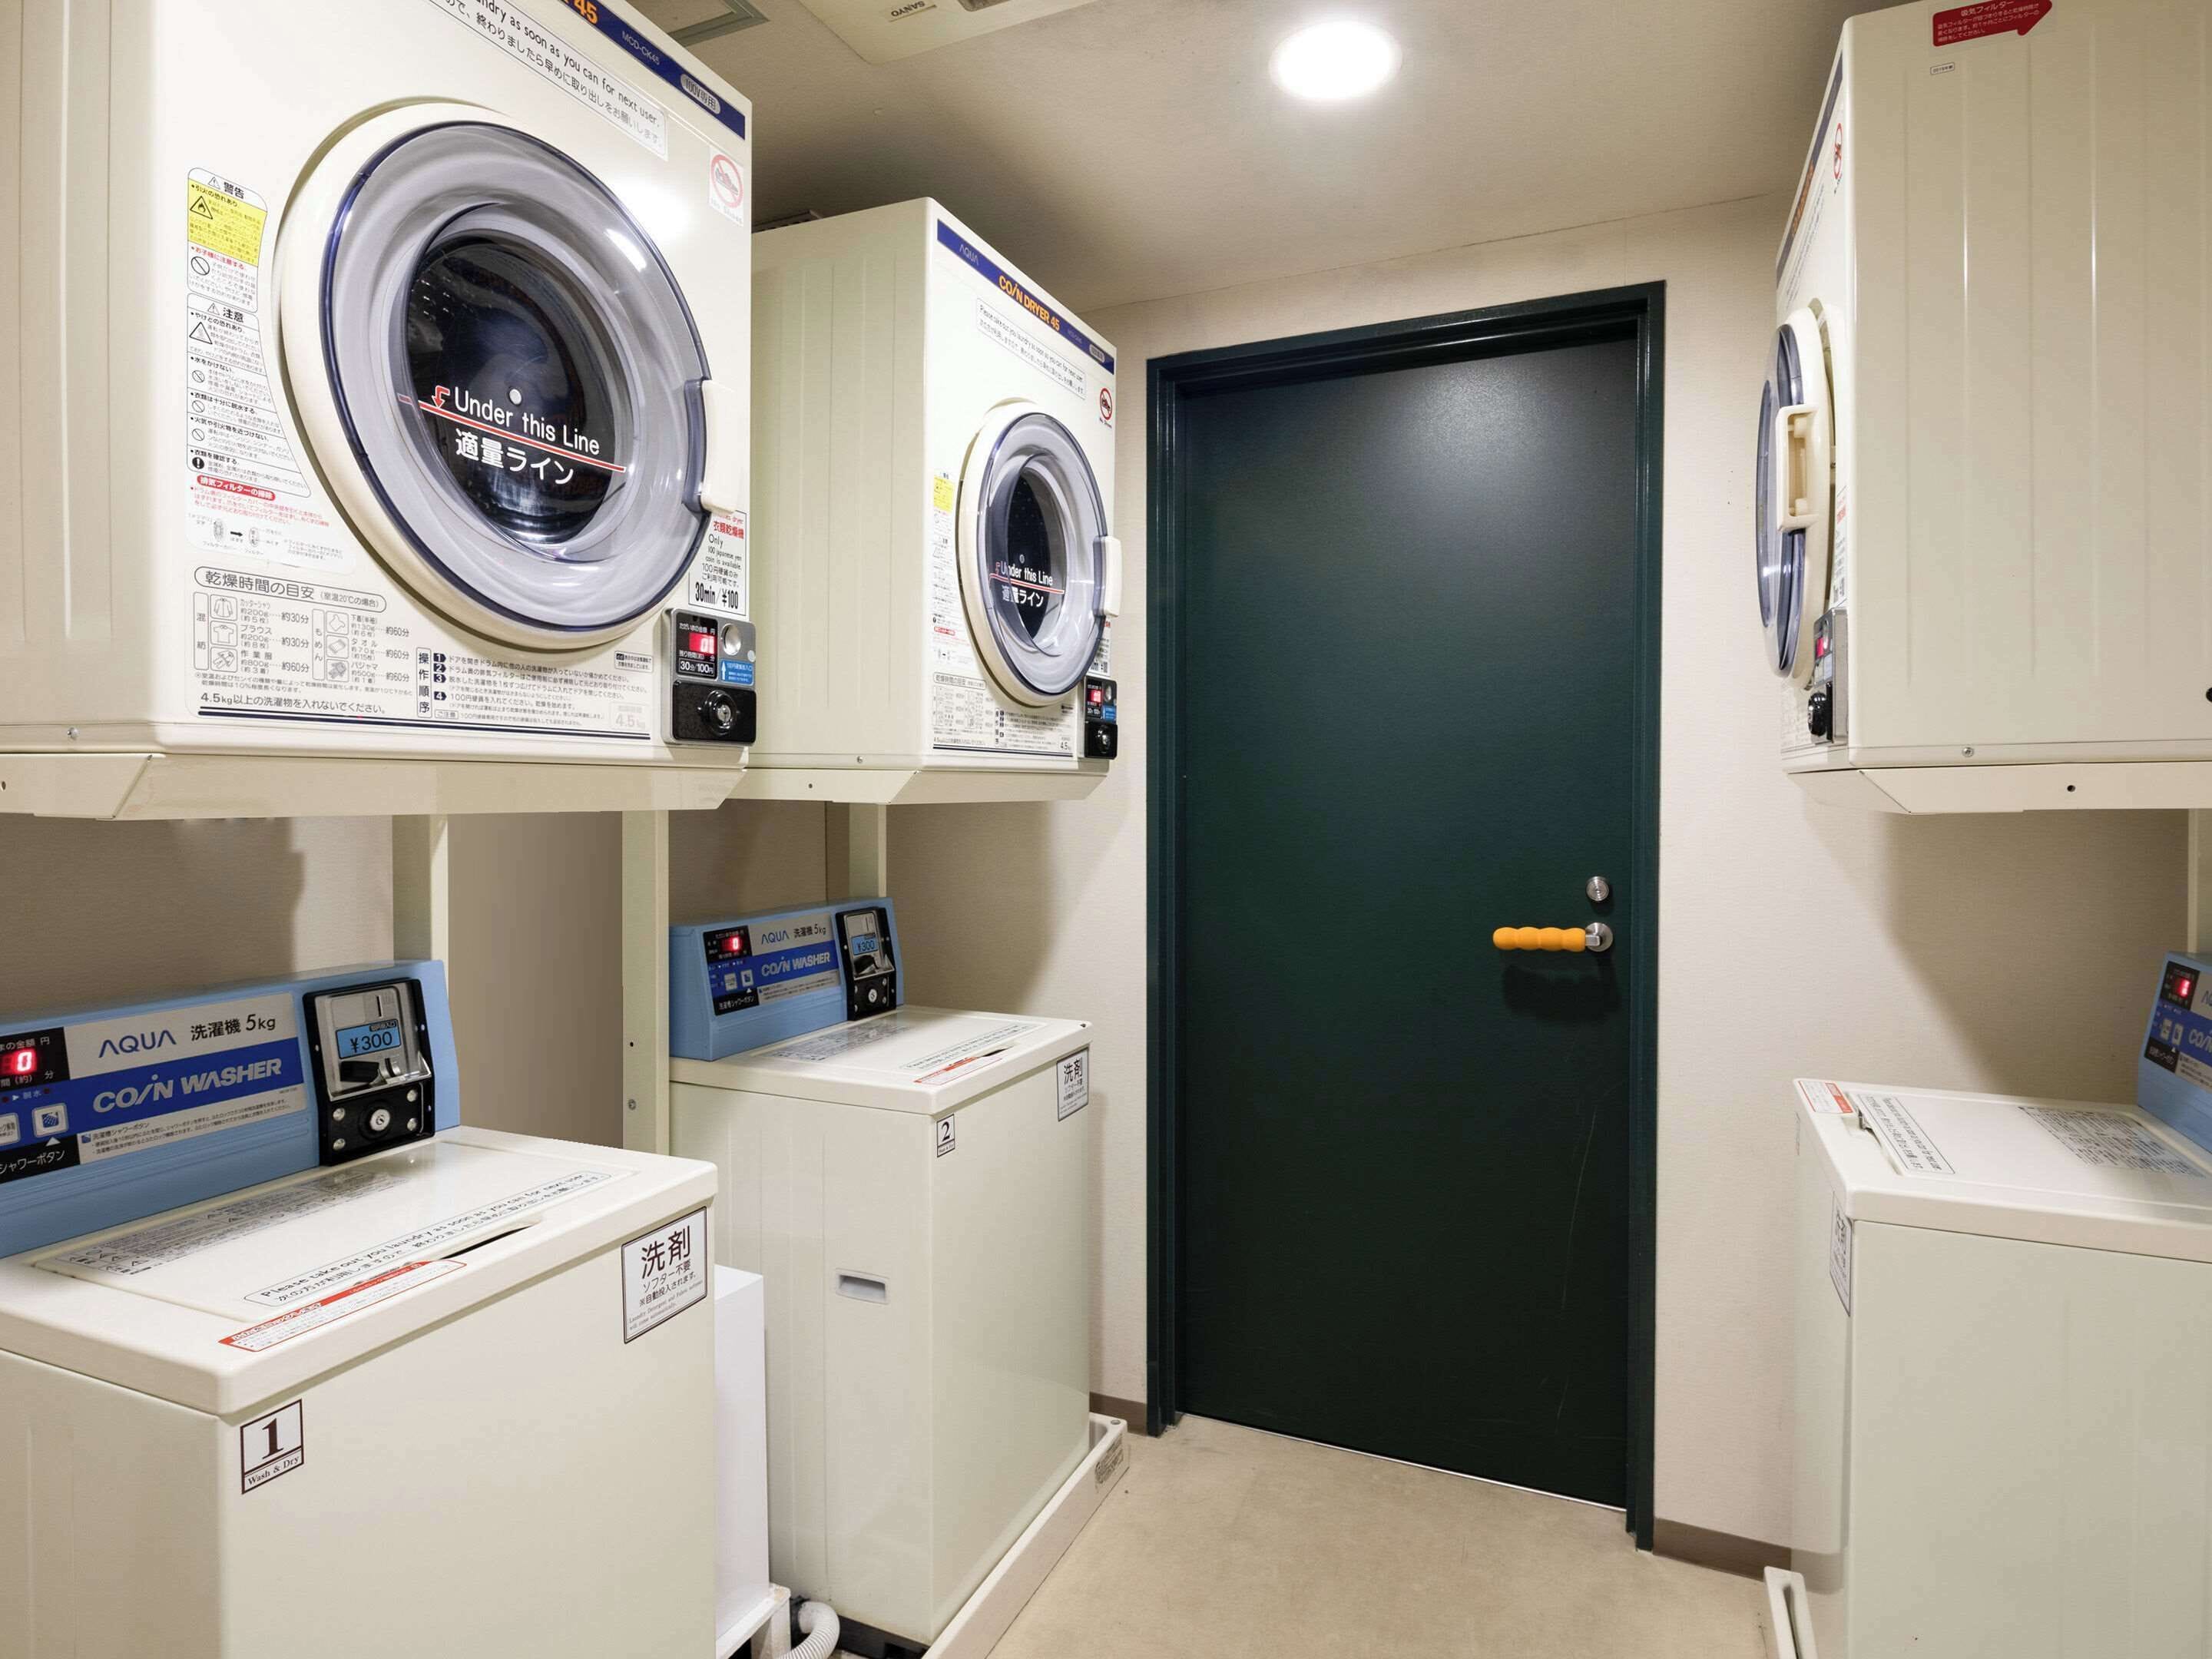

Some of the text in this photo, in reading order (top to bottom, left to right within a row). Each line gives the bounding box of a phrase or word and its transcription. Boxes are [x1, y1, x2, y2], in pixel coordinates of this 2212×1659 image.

[575, 0, 599, 25] 45
[891, 1, 925, 17] SANYO
[476, 0, 506, 23] ndry
[510, 16, 522, 31] as
[524, 26, 548, 49] soon
[550, 45, 561, 58] as
[564, 54, 581, 73] you
[582, 68, 599, 85] can
[602, 78, 616, 95] for
[618, 92, 638, 113] next
[224, 181, 245, 199] 警告
[223, 307, 244, 323] 注意
[1024, 293, 1051, 324] DRYER
[1050, 316, 1061, 332] 45
[454, 386, 600, 455] Under this Line
[455, 428, 575, 485] 適量ライン
[707, 545, 716, 555] 100
[708, 534, 724, 549] Only
[205, 571, 314, 601] 乾燥時間の目安
[1024, 567, 1037, 583] this
[1038, 570, 1054, 586] Line
[281, 611, 310, 624] 約30分
[240, 624, 273, 635] ブラウス
[281, 636, 310, 649] 約30分
[281, 661, 310, 674] 約60分
[760, 929, 790, 945] AQUA
[814, 923, 827, 936] 5kg
[792, 952, 831, 971] WASHER
[40, 1036, 51, 1046] 円
[98, 1013, 276, 1058] AQUA 洗濯機 5kg
[349, 1031, 393, 1053] ¥300
[16, 1051, 33, 1072] 0
[1063, 1056, 1083, 1085] 洗剤
[44, 1070, 55, 1080] 分
[92, 1057, 283, 1114] COIN WASHER
[941, 1121, 952, 1143] 2
[641, 1225, 691, 1280] 洗剤
[260, 1277, 309, 1298] Please
[309, 1267, 339, 1280] take
[339, 1257, 363, 1269] out
[363, 1248, 386, 1260] you
[386, 1230, 433, 1250] laundry
[643, 1258, 691, 1293] ソフター不要
[261, 1417, 284, 1460] 1
[247, 1455, 300, 1486] Wash & Dry
